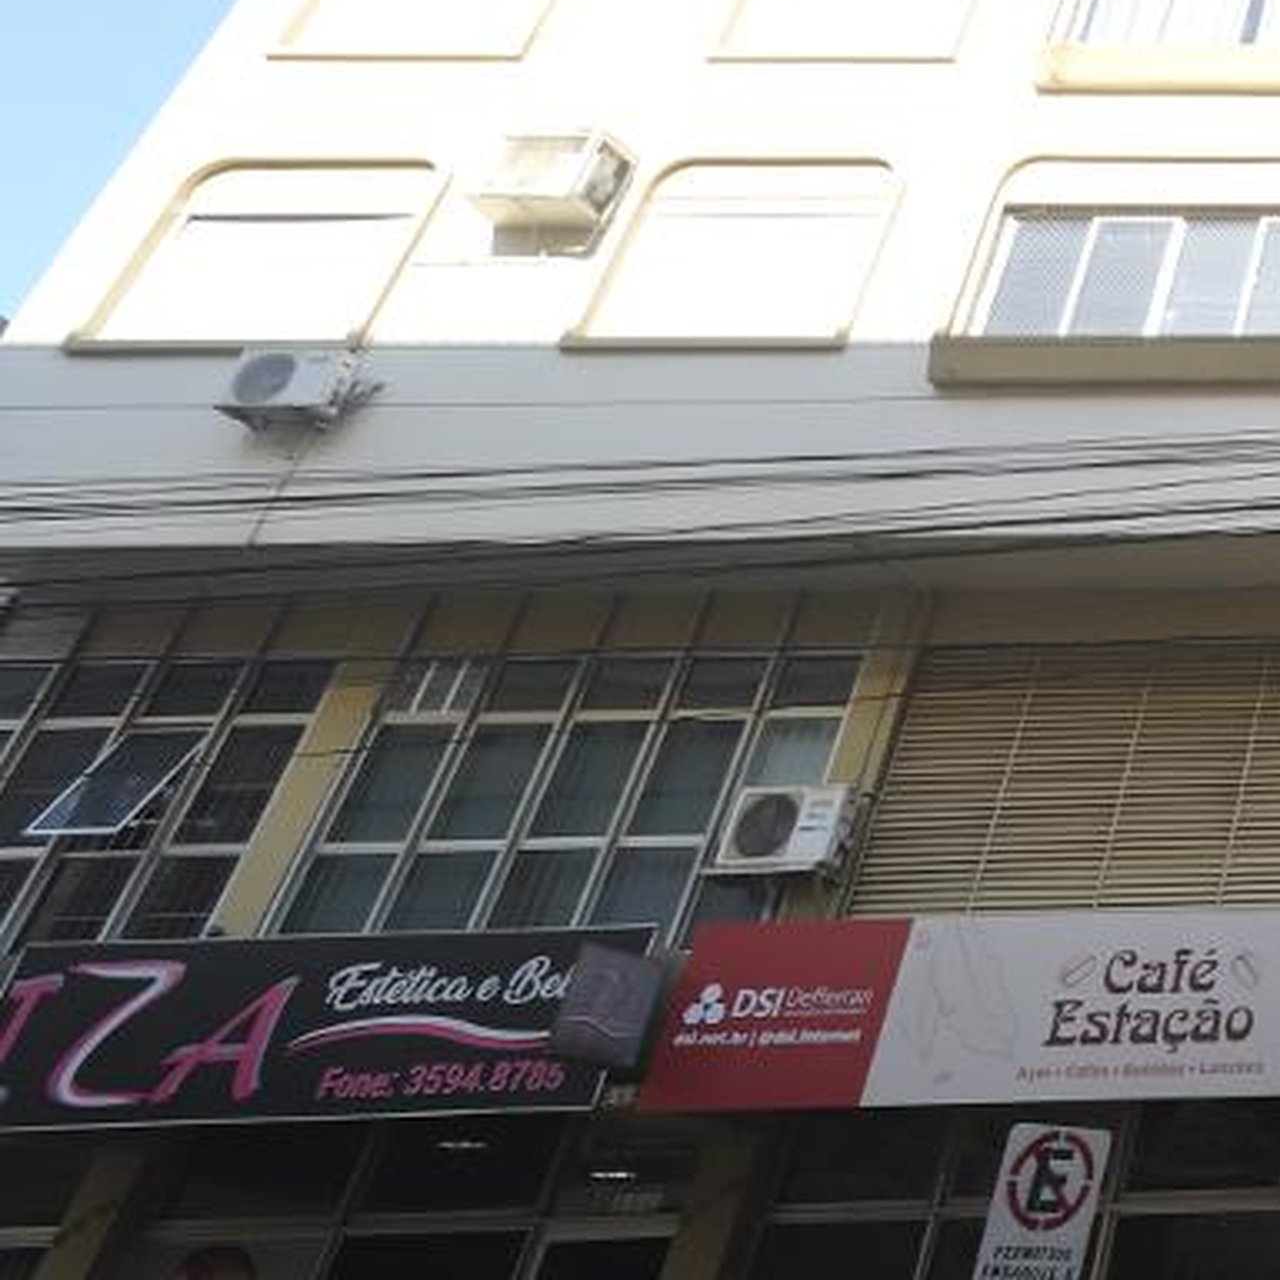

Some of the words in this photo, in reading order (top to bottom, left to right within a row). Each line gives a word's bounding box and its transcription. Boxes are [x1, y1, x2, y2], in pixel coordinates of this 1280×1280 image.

[325, 962, 474, 1011] Estética
[476, 974, 500, 1002] e
[1103, 948, 1220, 994] Café
[731, 987, 785, 1018] DSI
[1041, 998, 1254, 1054] Estação
[318, 1066, 400, 1101] Fone:
